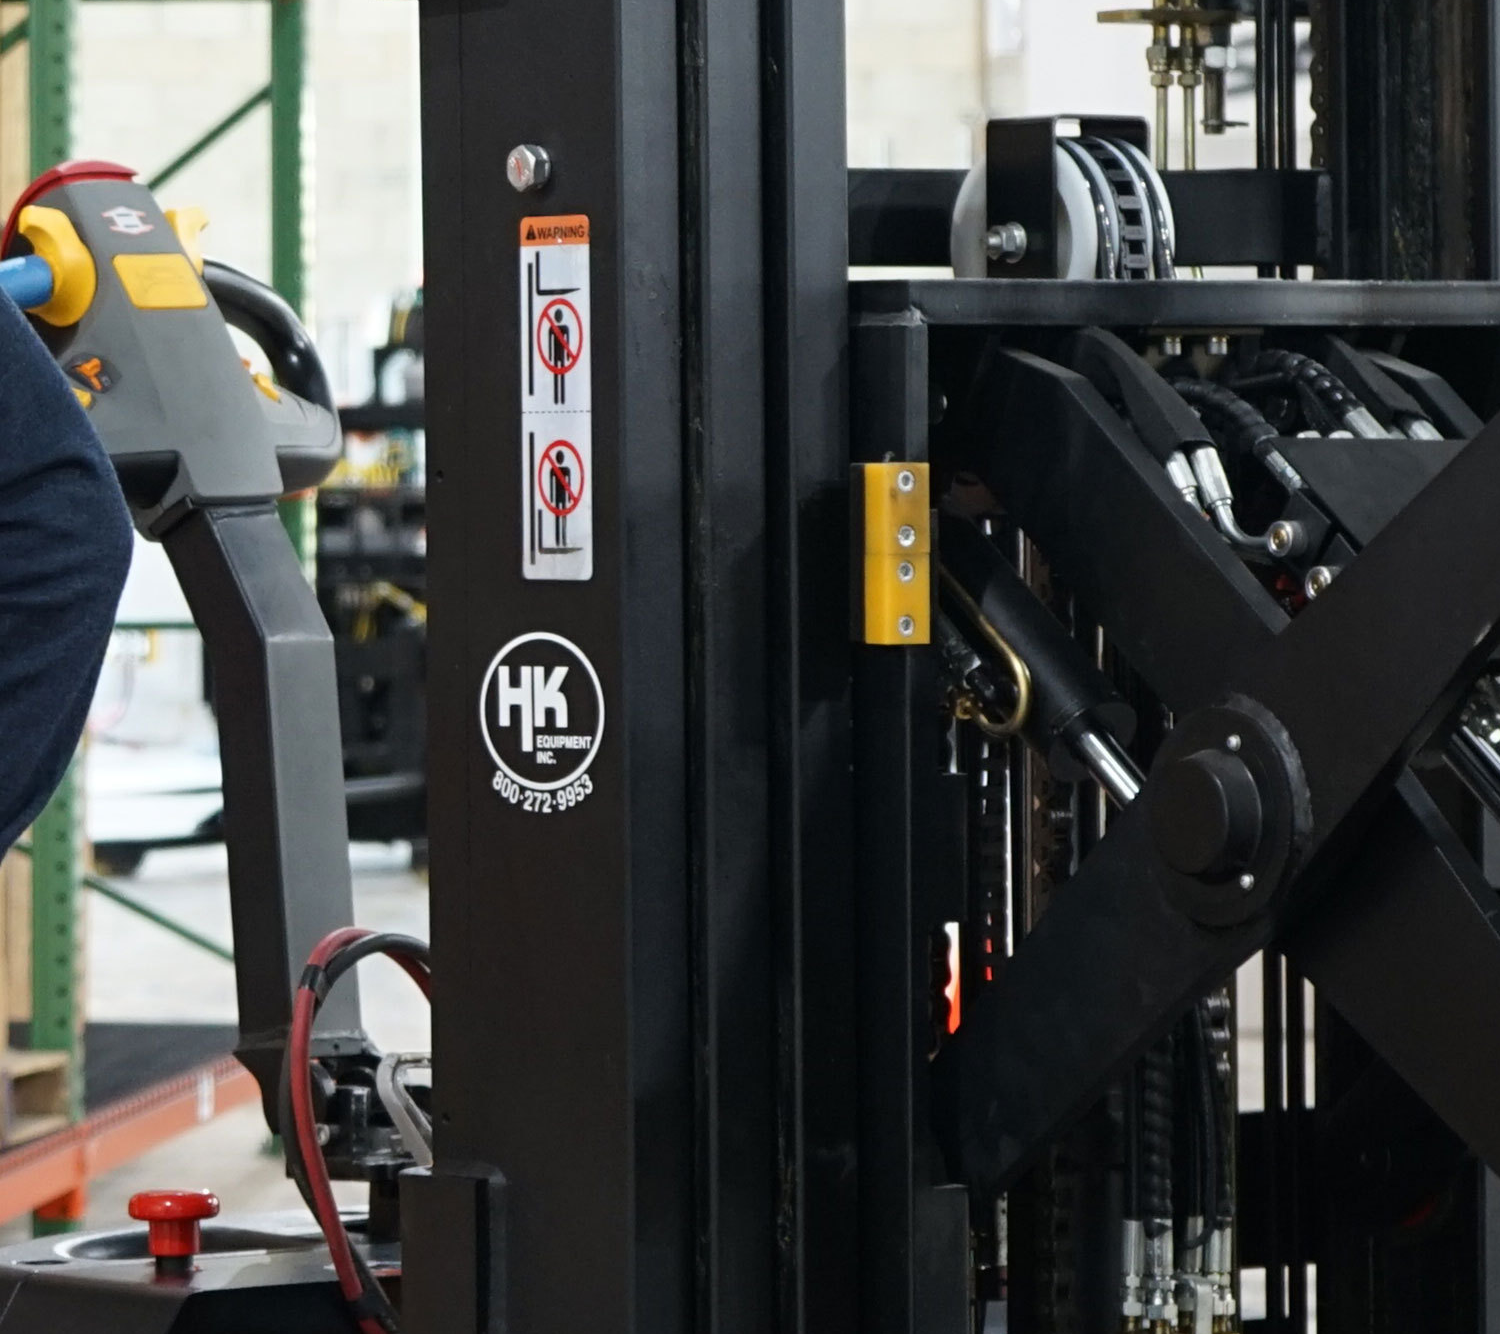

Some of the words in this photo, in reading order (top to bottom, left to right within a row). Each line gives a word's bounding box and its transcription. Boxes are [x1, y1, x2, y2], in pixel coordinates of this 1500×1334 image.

[537, 224, 585, 241] WARNING
[498, 665, 569, 753] HK
[536, 734, 593, 750] EQUIPMENT
[536, 751, 557, 765] INC.
